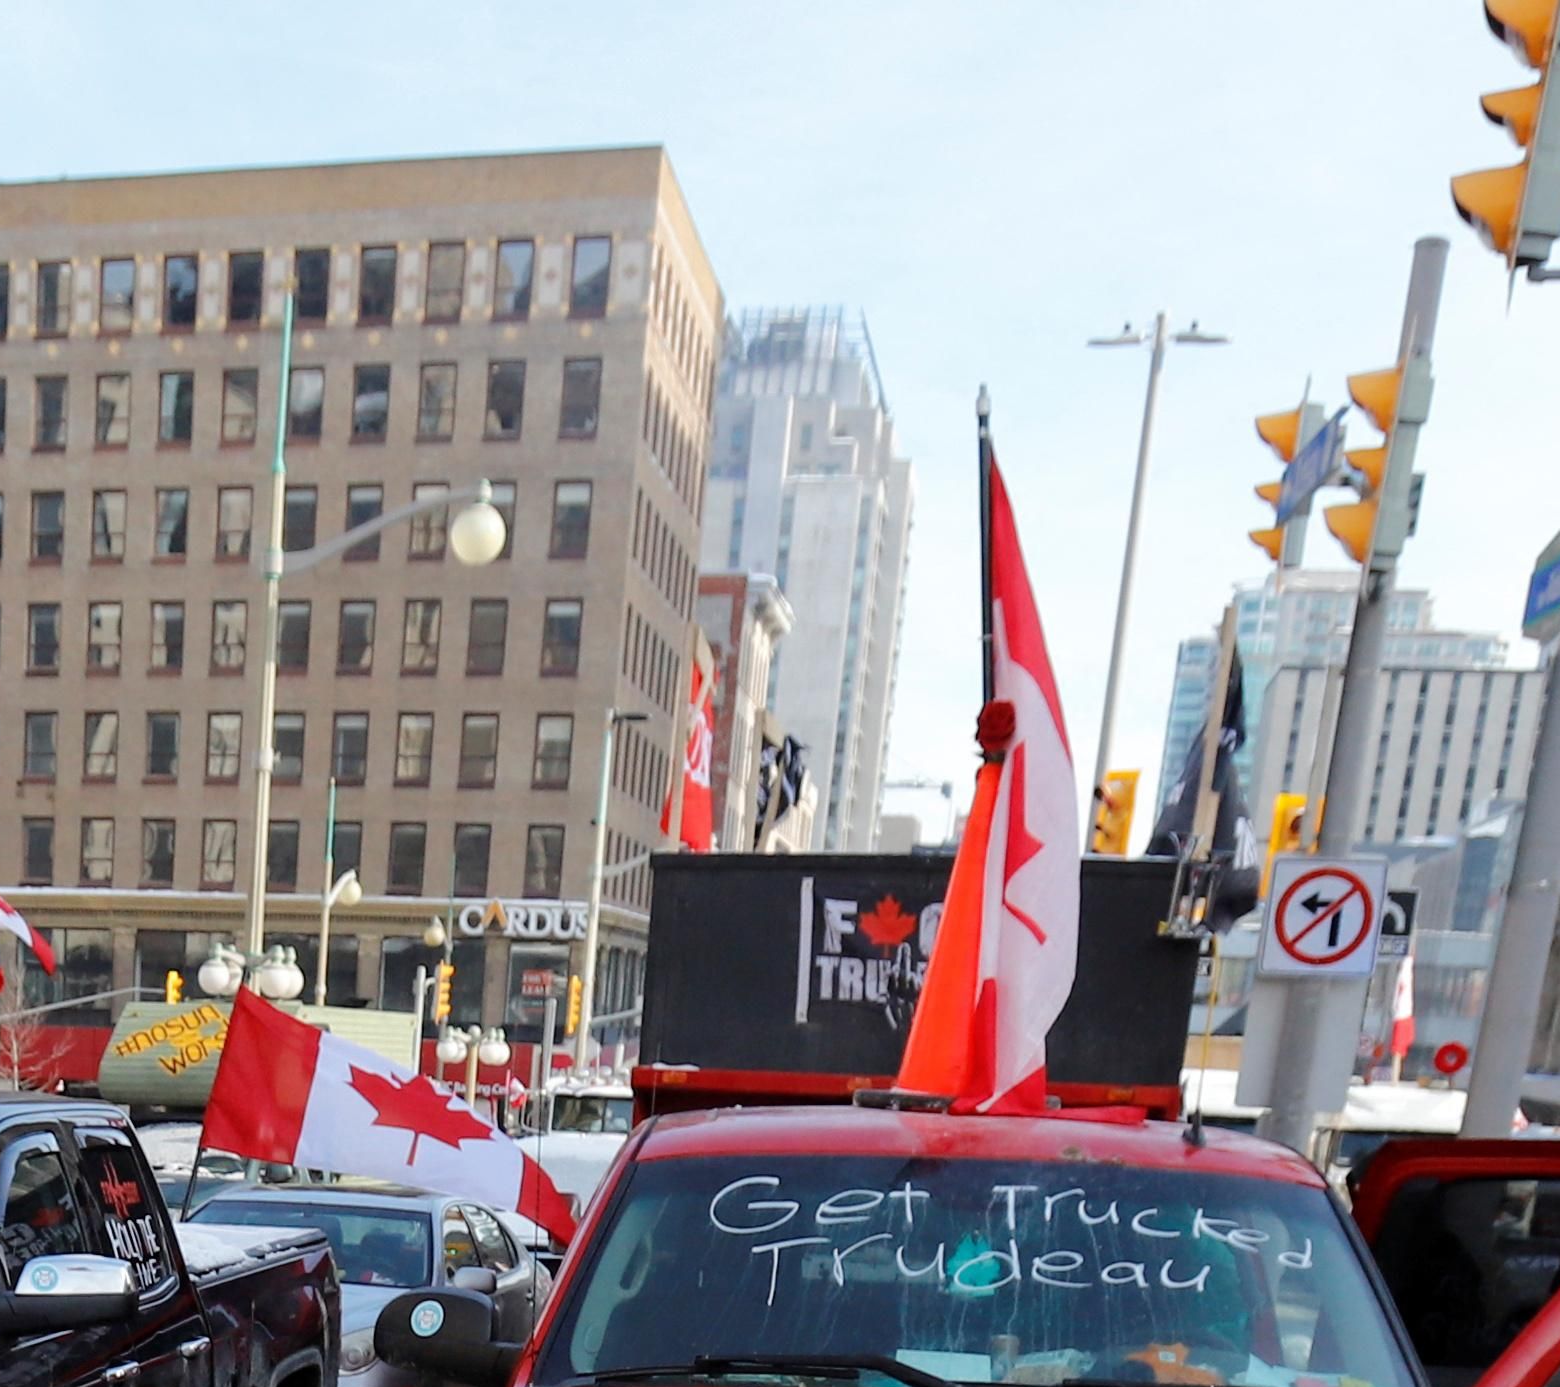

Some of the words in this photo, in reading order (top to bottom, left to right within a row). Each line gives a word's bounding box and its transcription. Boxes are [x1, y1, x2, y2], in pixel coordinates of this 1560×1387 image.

[458, 897, 588, 938] CARDUS
[709, 1176, 931, 1235] Get
[992, 1183, 1313, 1269] Trucked
[751, 1232, 1213, 1306] Trudeau
